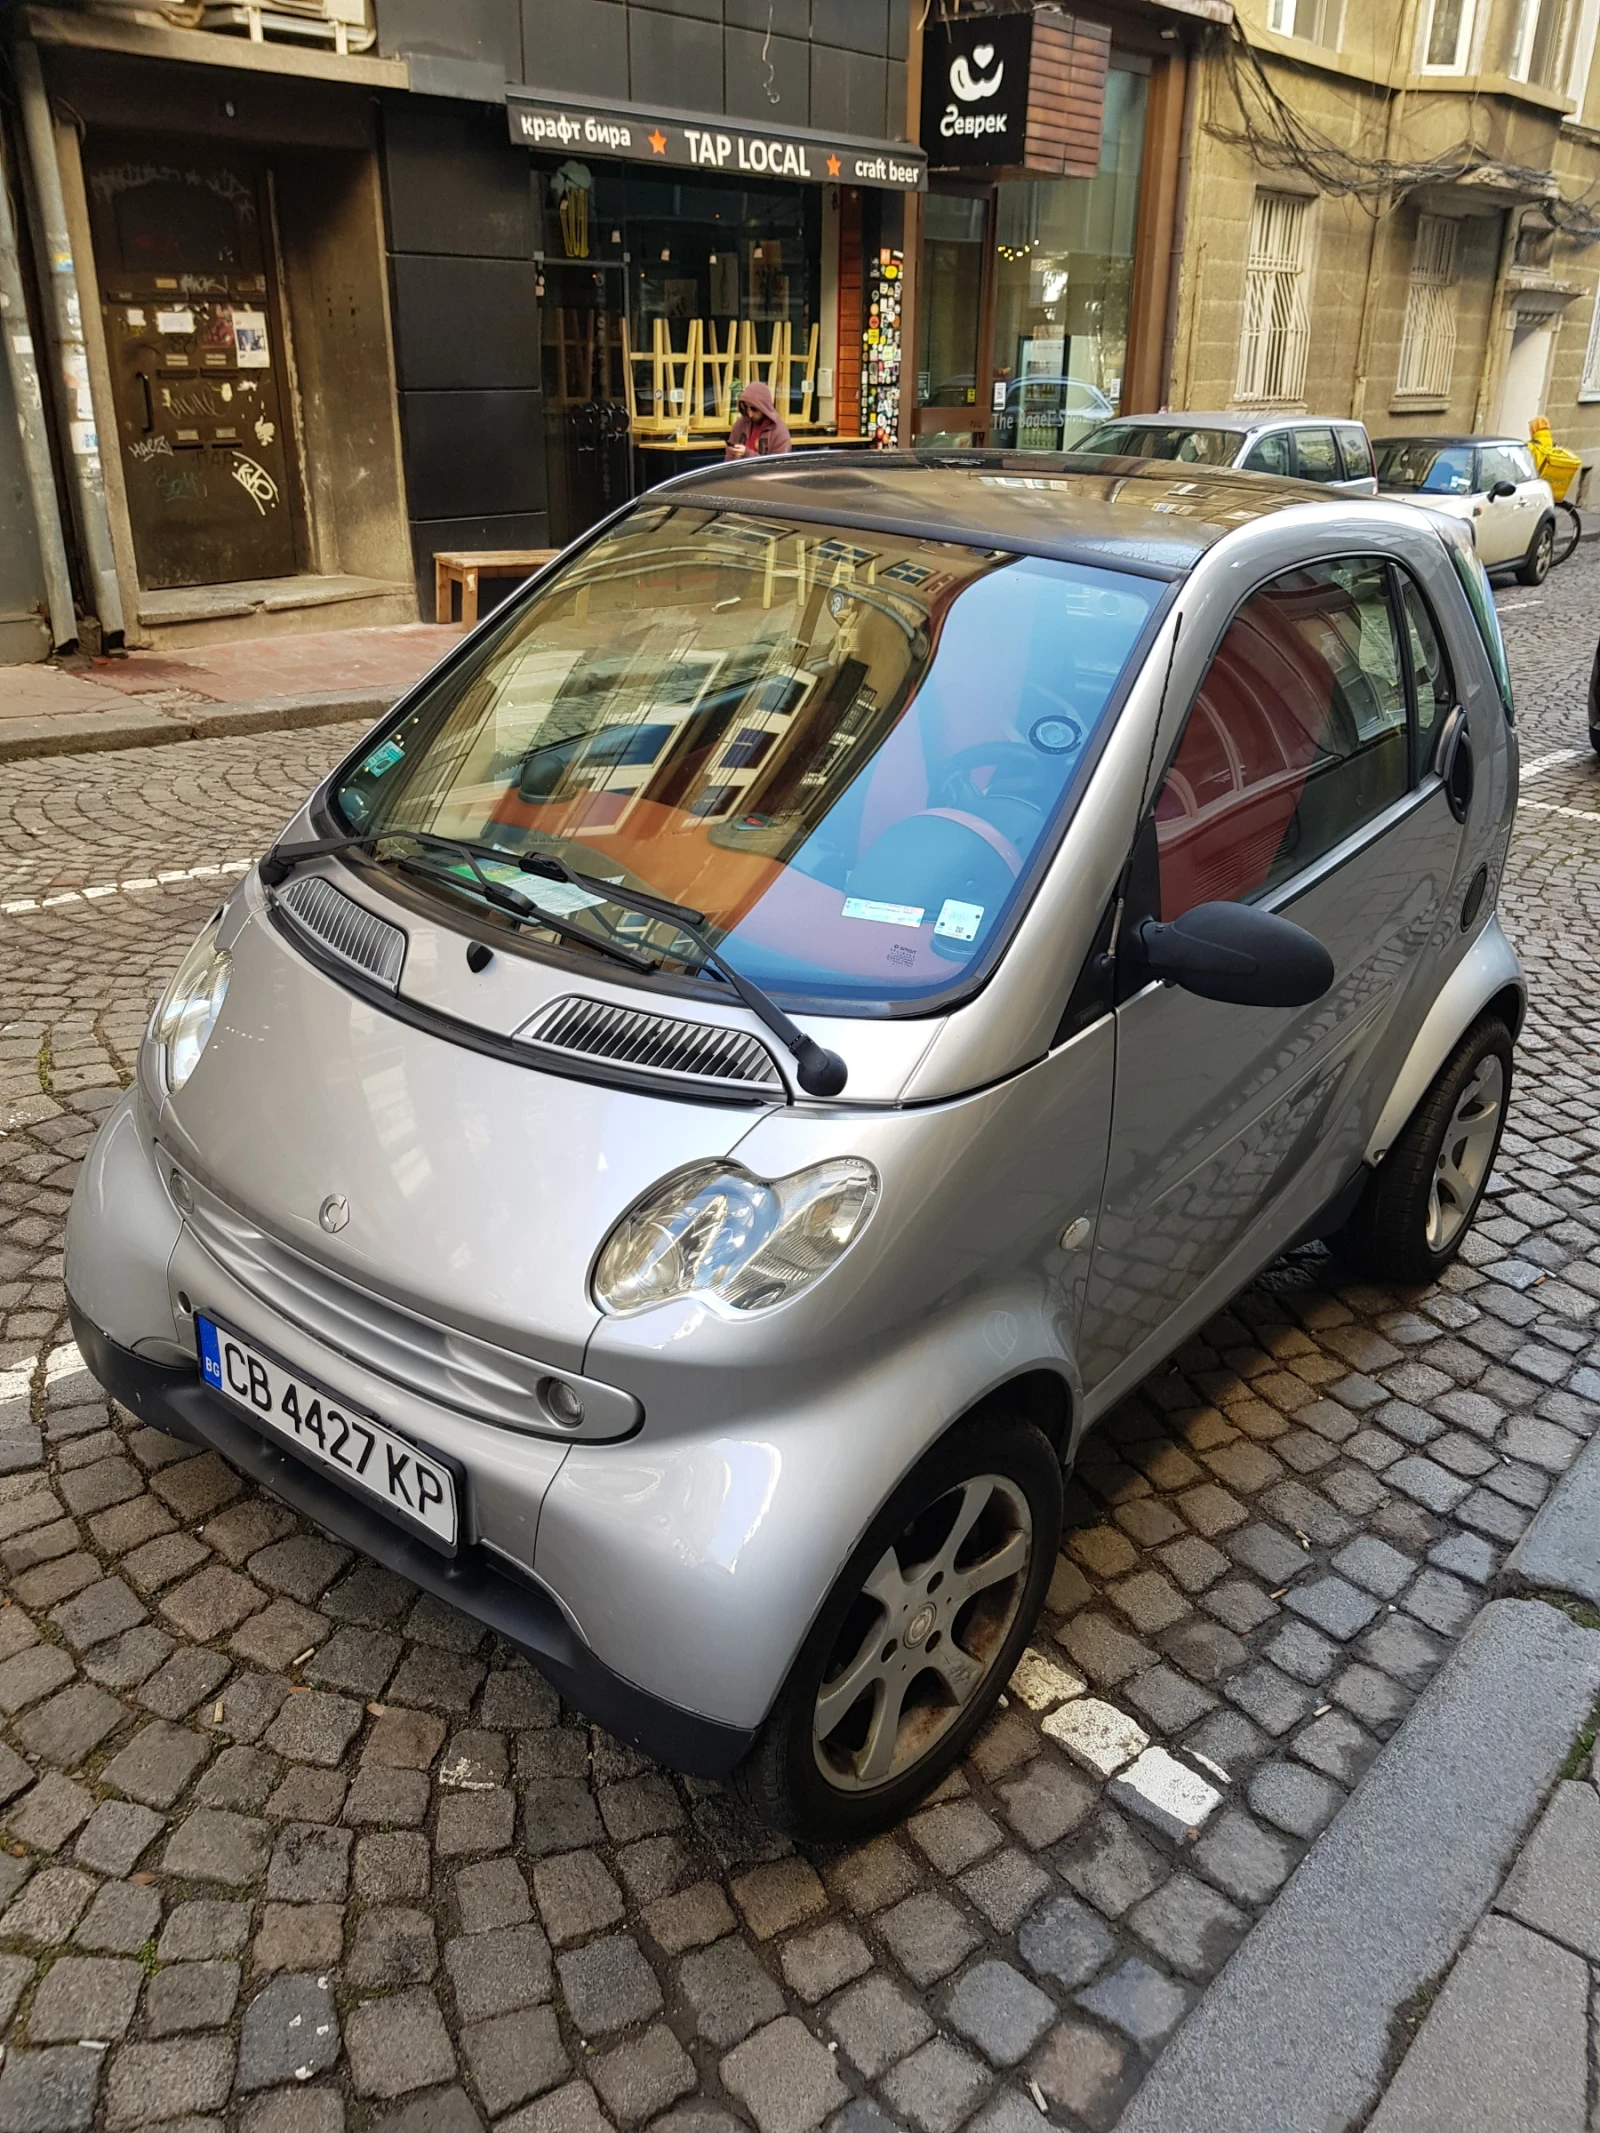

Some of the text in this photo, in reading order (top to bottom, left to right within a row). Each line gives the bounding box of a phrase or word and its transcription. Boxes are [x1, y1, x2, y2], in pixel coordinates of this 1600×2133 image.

[520, 114, 631, 149] крафт бира
[684, 130, 811, 177] TAP LOCAL
[855, 160, 919, 184] craft beer
[992, 412, 1014, 430] The
[205, 1356, 220, 1378] BG
[224, 1342, 443, 1515] CB 4427 KP
